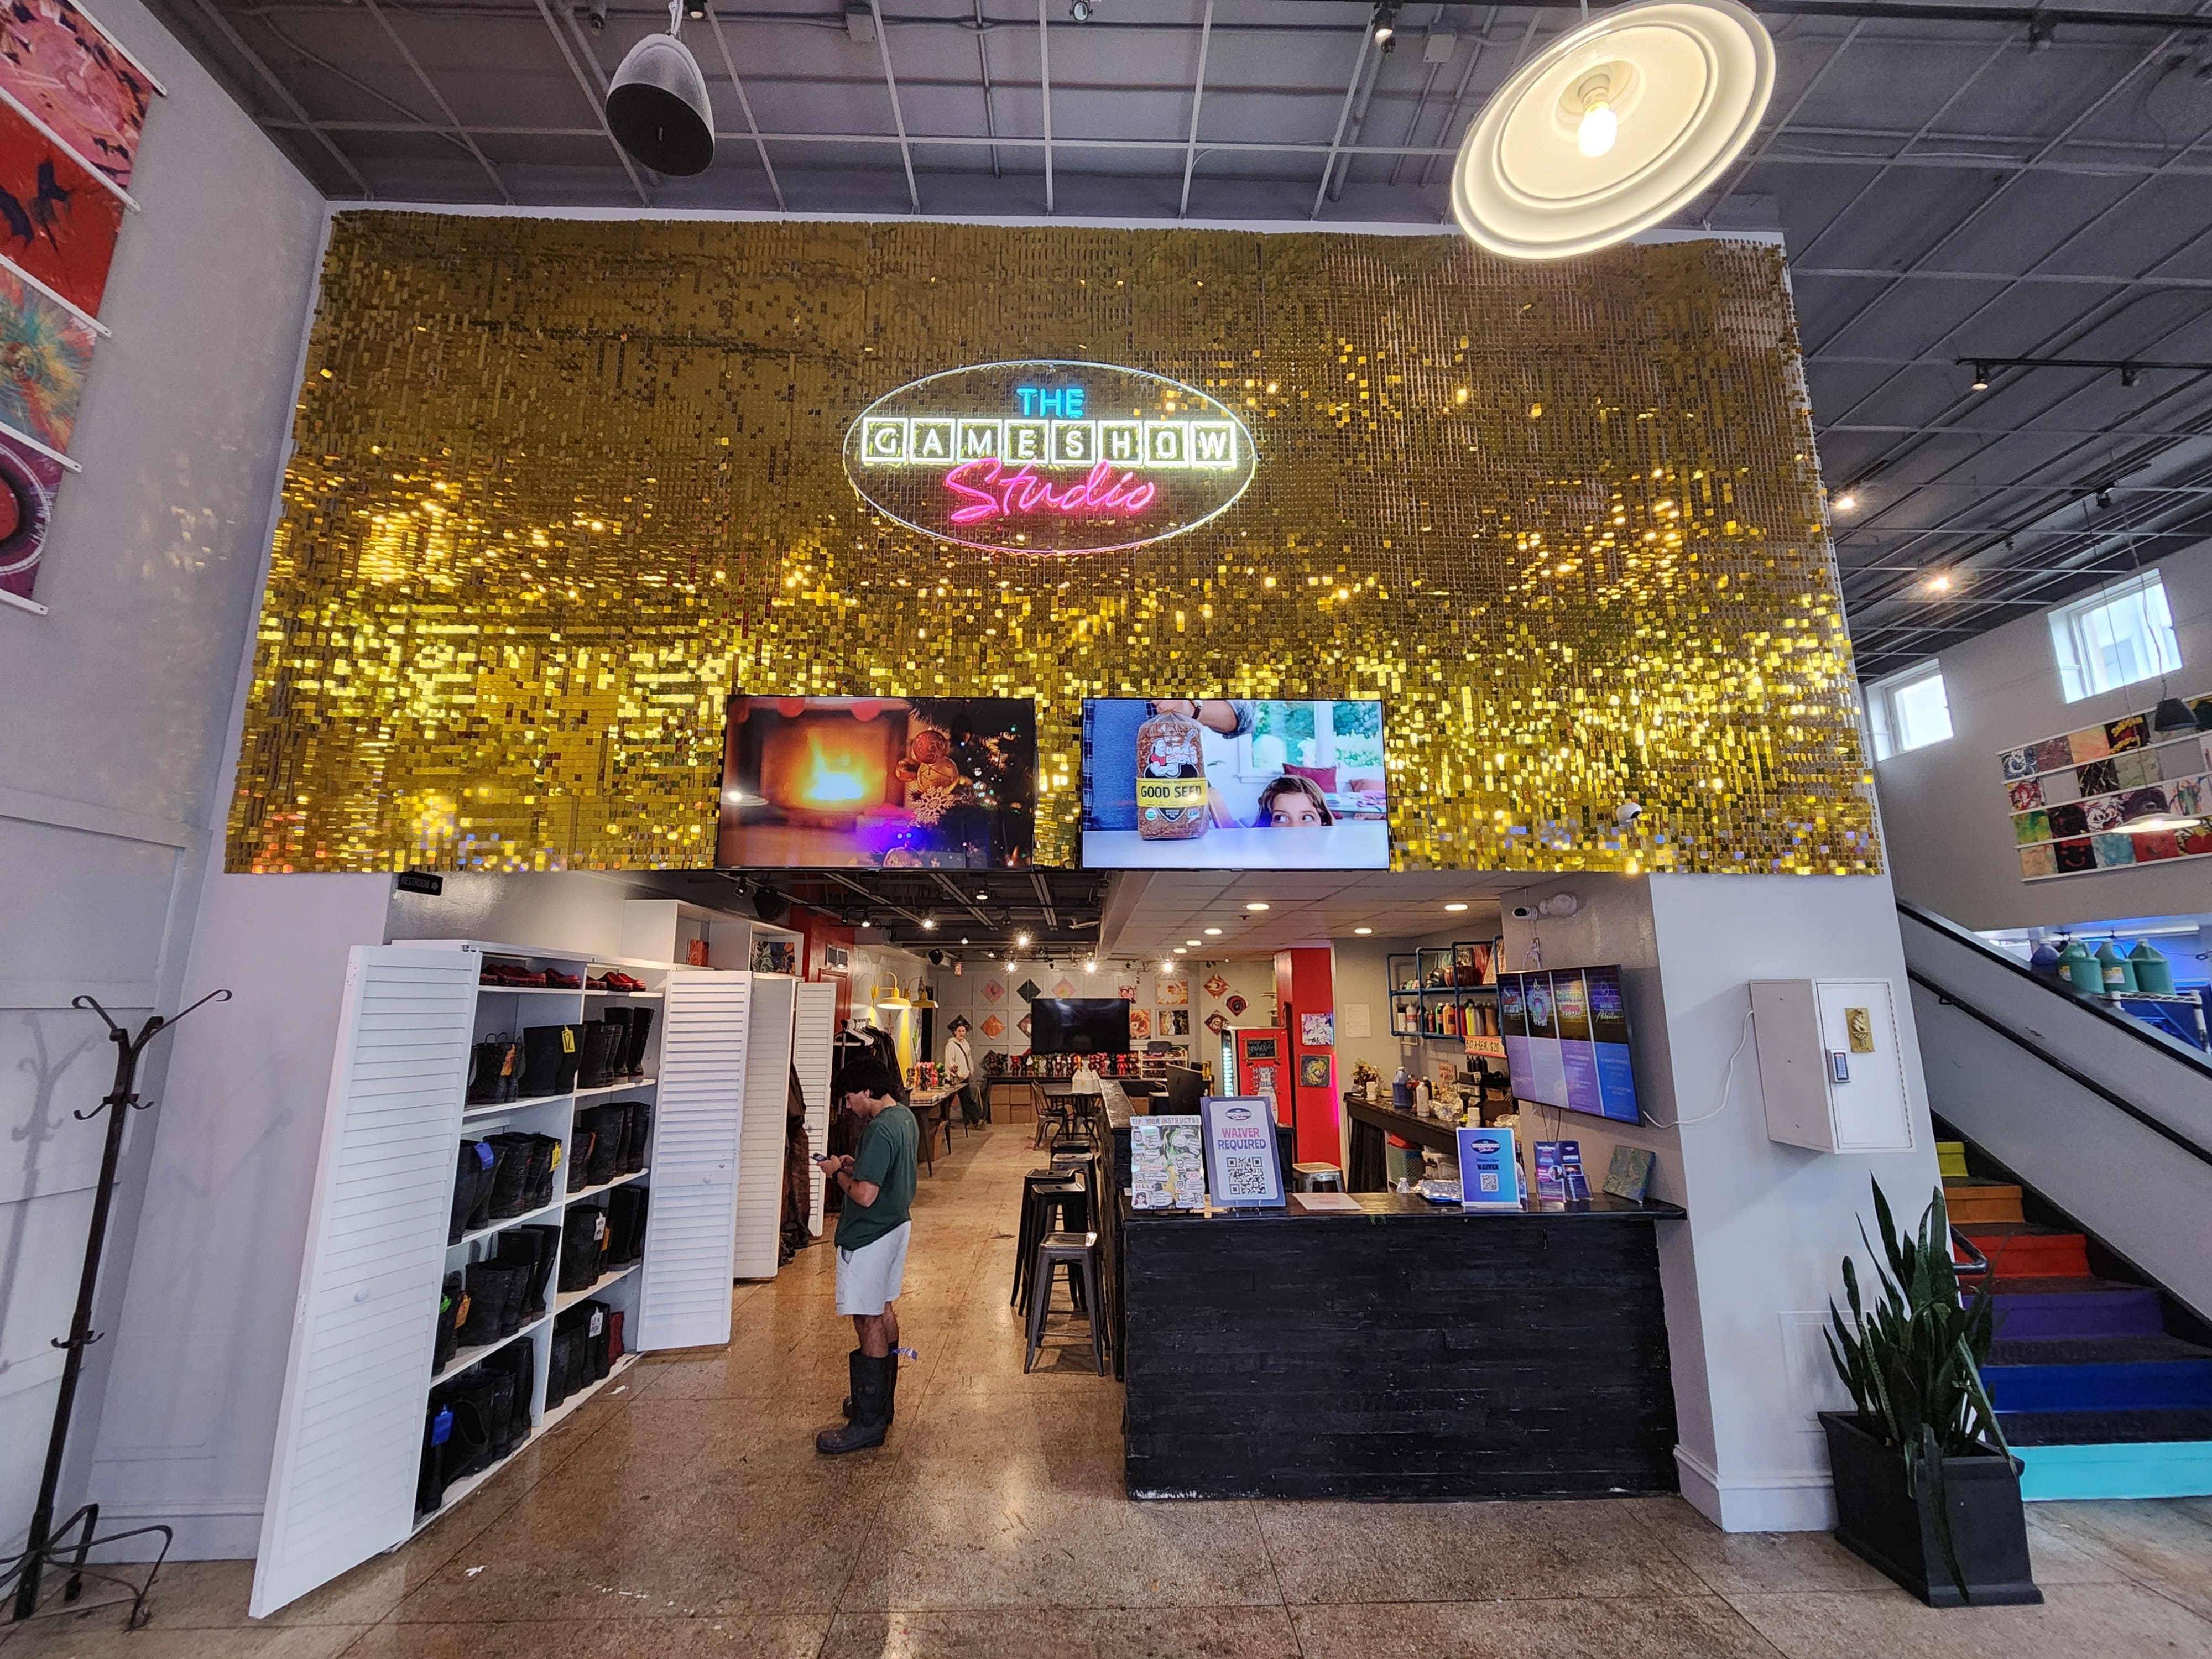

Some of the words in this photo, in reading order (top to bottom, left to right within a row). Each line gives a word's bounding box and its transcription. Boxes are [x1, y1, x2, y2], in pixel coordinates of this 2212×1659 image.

[1016, 387, 1086, 418] THE
[872, 424, 1229, 460] GAMESHOW
[943, 457, 1156, 523] Studio
[1141, 786, 1171, 798] GOOD
[1174, 785, 1202, 798] SEED
[401, 877, 430, 888] RESTROOM
[1222, 1128, 1260, 1138] WAIVER
[1218, 1139, 1267, 1151] REQUIRED
